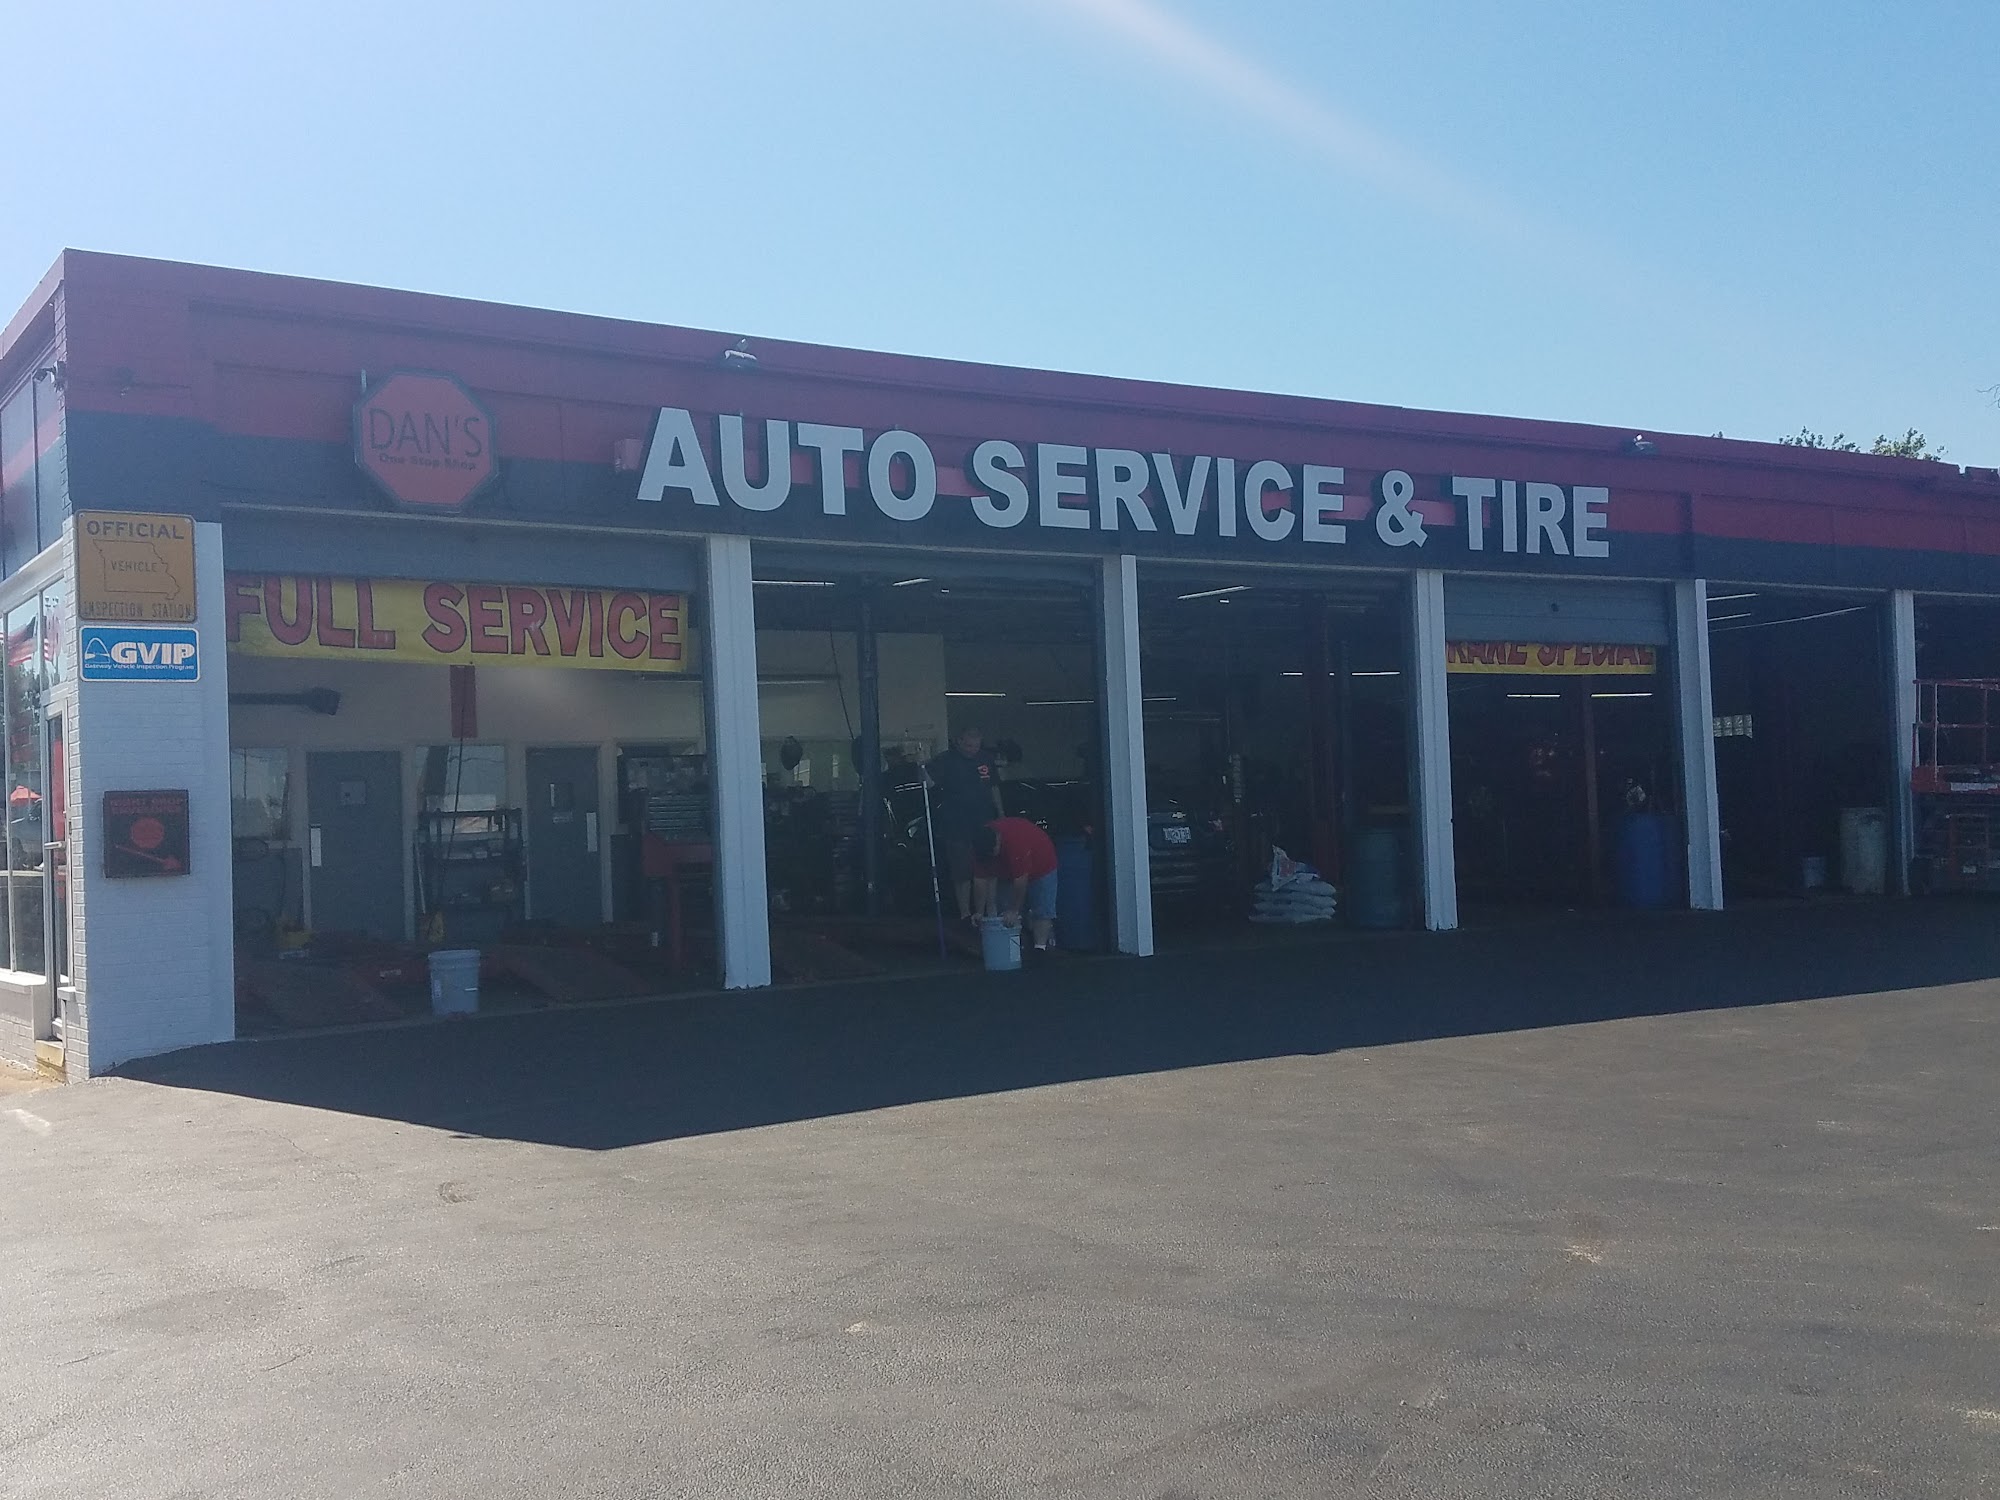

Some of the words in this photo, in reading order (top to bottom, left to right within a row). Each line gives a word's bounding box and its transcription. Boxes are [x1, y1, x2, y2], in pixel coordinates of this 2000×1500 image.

[369, 408, 482, 458] DAN'S
[379, 453, 405, 465] One
[411, 455, 440, 469] Stop
[637, 406, 937, 521] AUTO
[971, 440, 1346, 545] SERVICE
[1376, 470, 1428, 548] &
[1452, 476, 1610, 558] TIRE
[86, 520, 185, 540] OFFICIAL
[110, 561, 158, 573] VEHICLE
[84, 600, 144, 618] INSPECTION
[151, 602, 192, 619] STATION
[225, 574, 396, 650] FULL
[421, 581, 682, 661] SERVICE
[111, 641, 196, 665] GVIP
[136, 663, 168, 671] Inspection
